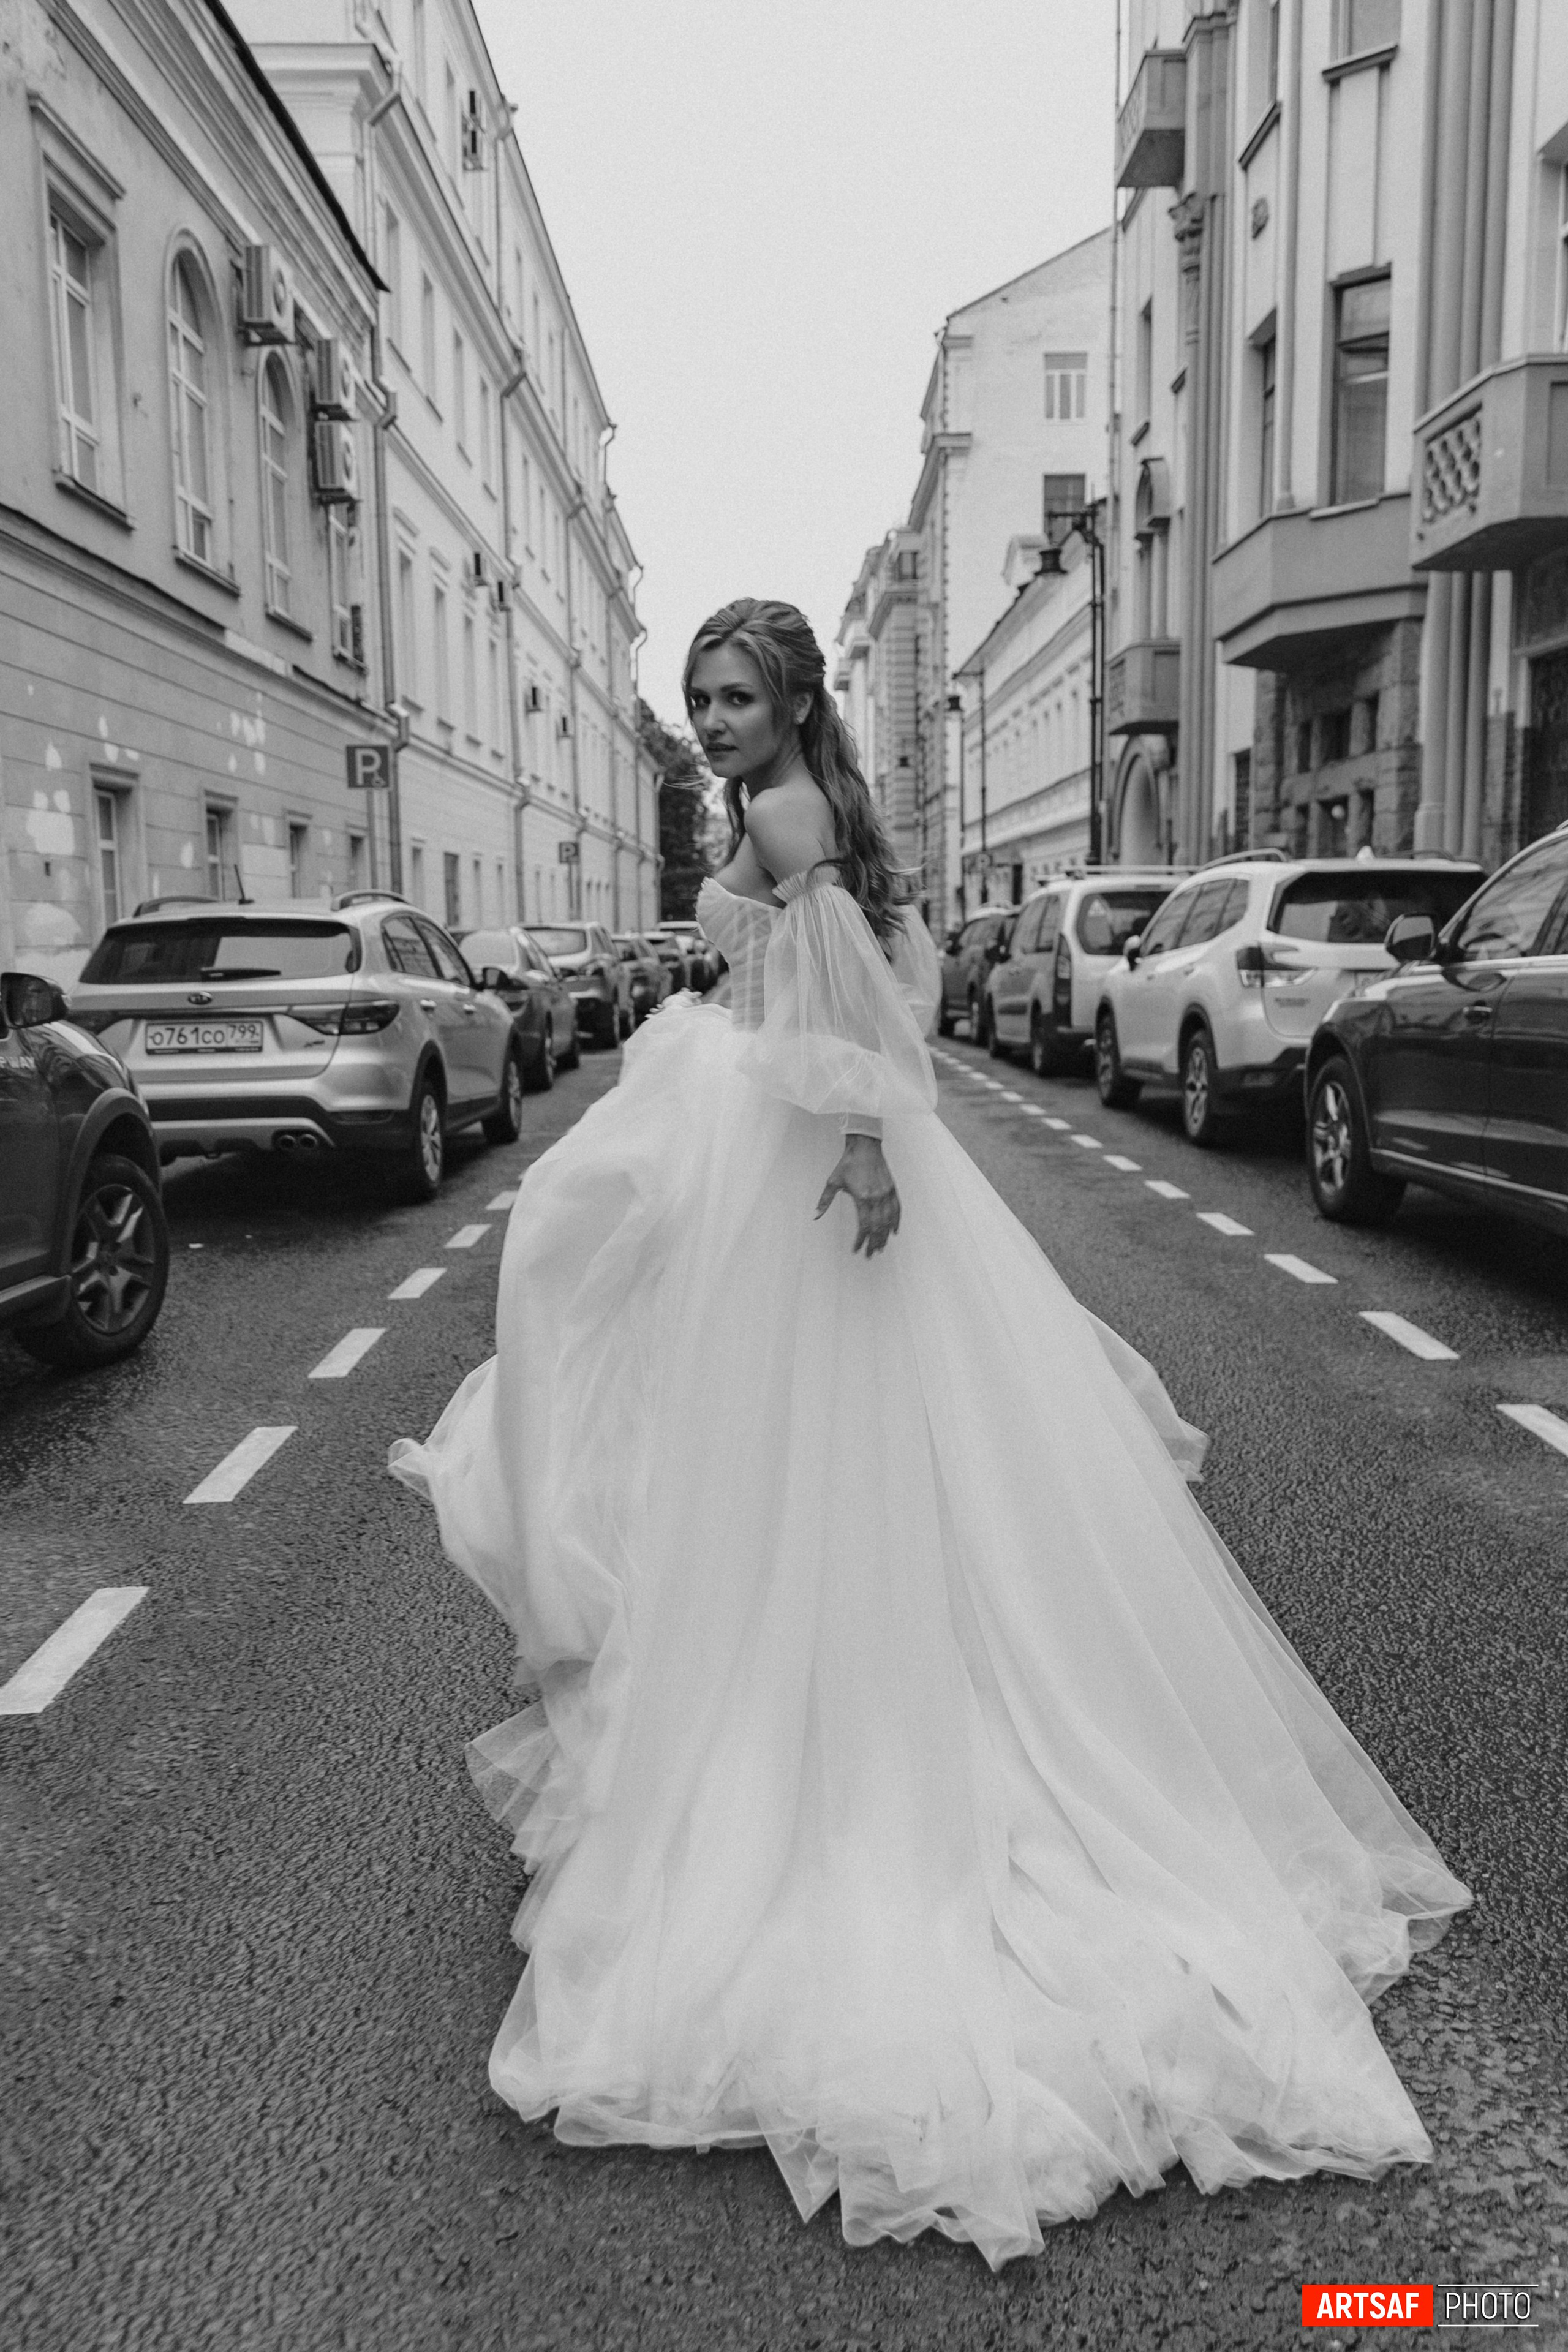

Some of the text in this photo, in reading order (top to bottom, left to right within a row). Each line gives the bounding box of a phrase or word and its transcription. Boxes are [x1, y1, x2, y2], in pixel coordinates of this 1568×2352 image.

[355, 748, 382, 785] P
[562, 843, 576, 862] P
[229, 1024, 256, 1038] 799
